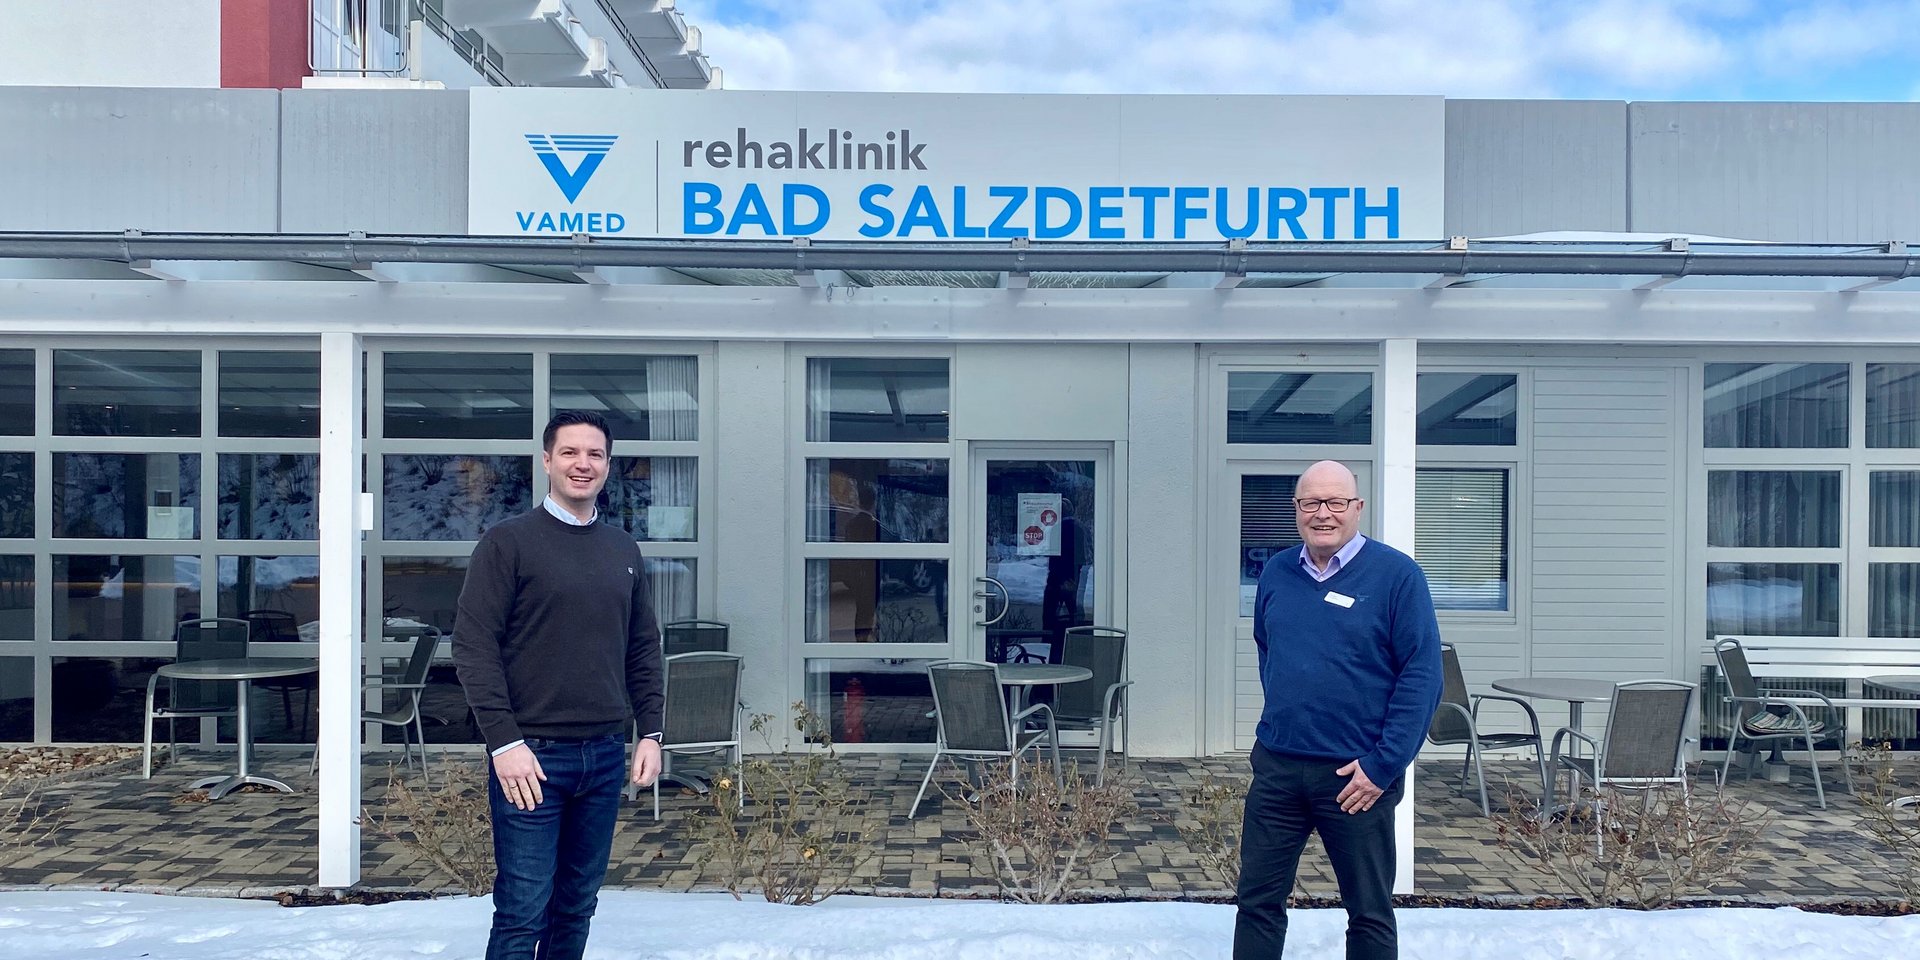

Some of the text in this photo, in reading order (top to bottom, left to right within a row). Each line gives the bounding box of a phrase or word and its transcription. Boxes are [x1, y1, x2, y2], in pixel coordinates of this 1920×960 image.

[684, 127, 928, 171] rehaklinik
[516, 211, 626, 233] VAMED
[683, 182, 1400, 240] BAD SALZDETFURTH
